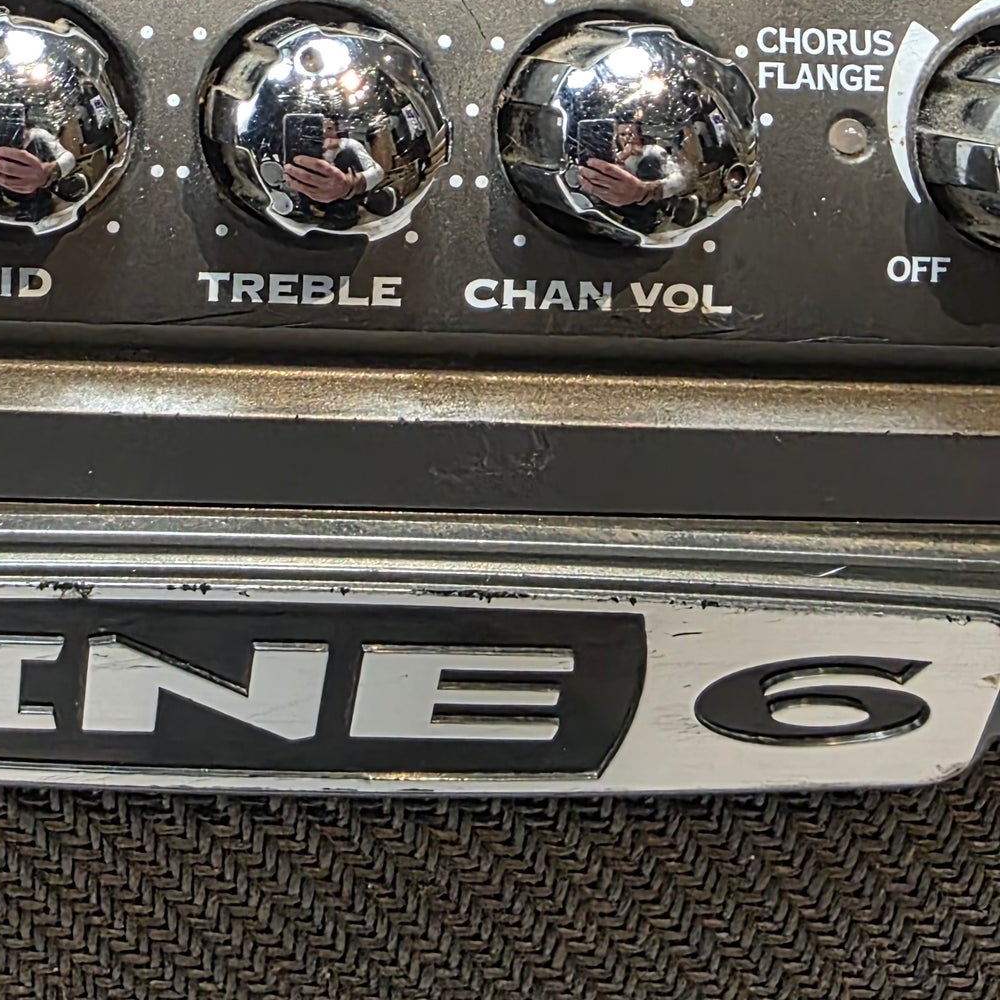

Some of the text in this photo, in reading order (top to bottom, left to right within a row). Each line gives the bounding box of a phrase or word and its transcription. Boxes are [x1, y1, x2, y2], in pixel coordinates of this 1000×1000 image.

[756, 26, 894, 57] CHORUS
[758, 62, 885, 92] FLANGE
[886, 255, 951, 283] OFF
[198, 271, 403, 307] TREBLE
[464, 278, 733, 314] CHAN VOL
[694, 656, 933, 747] 6
